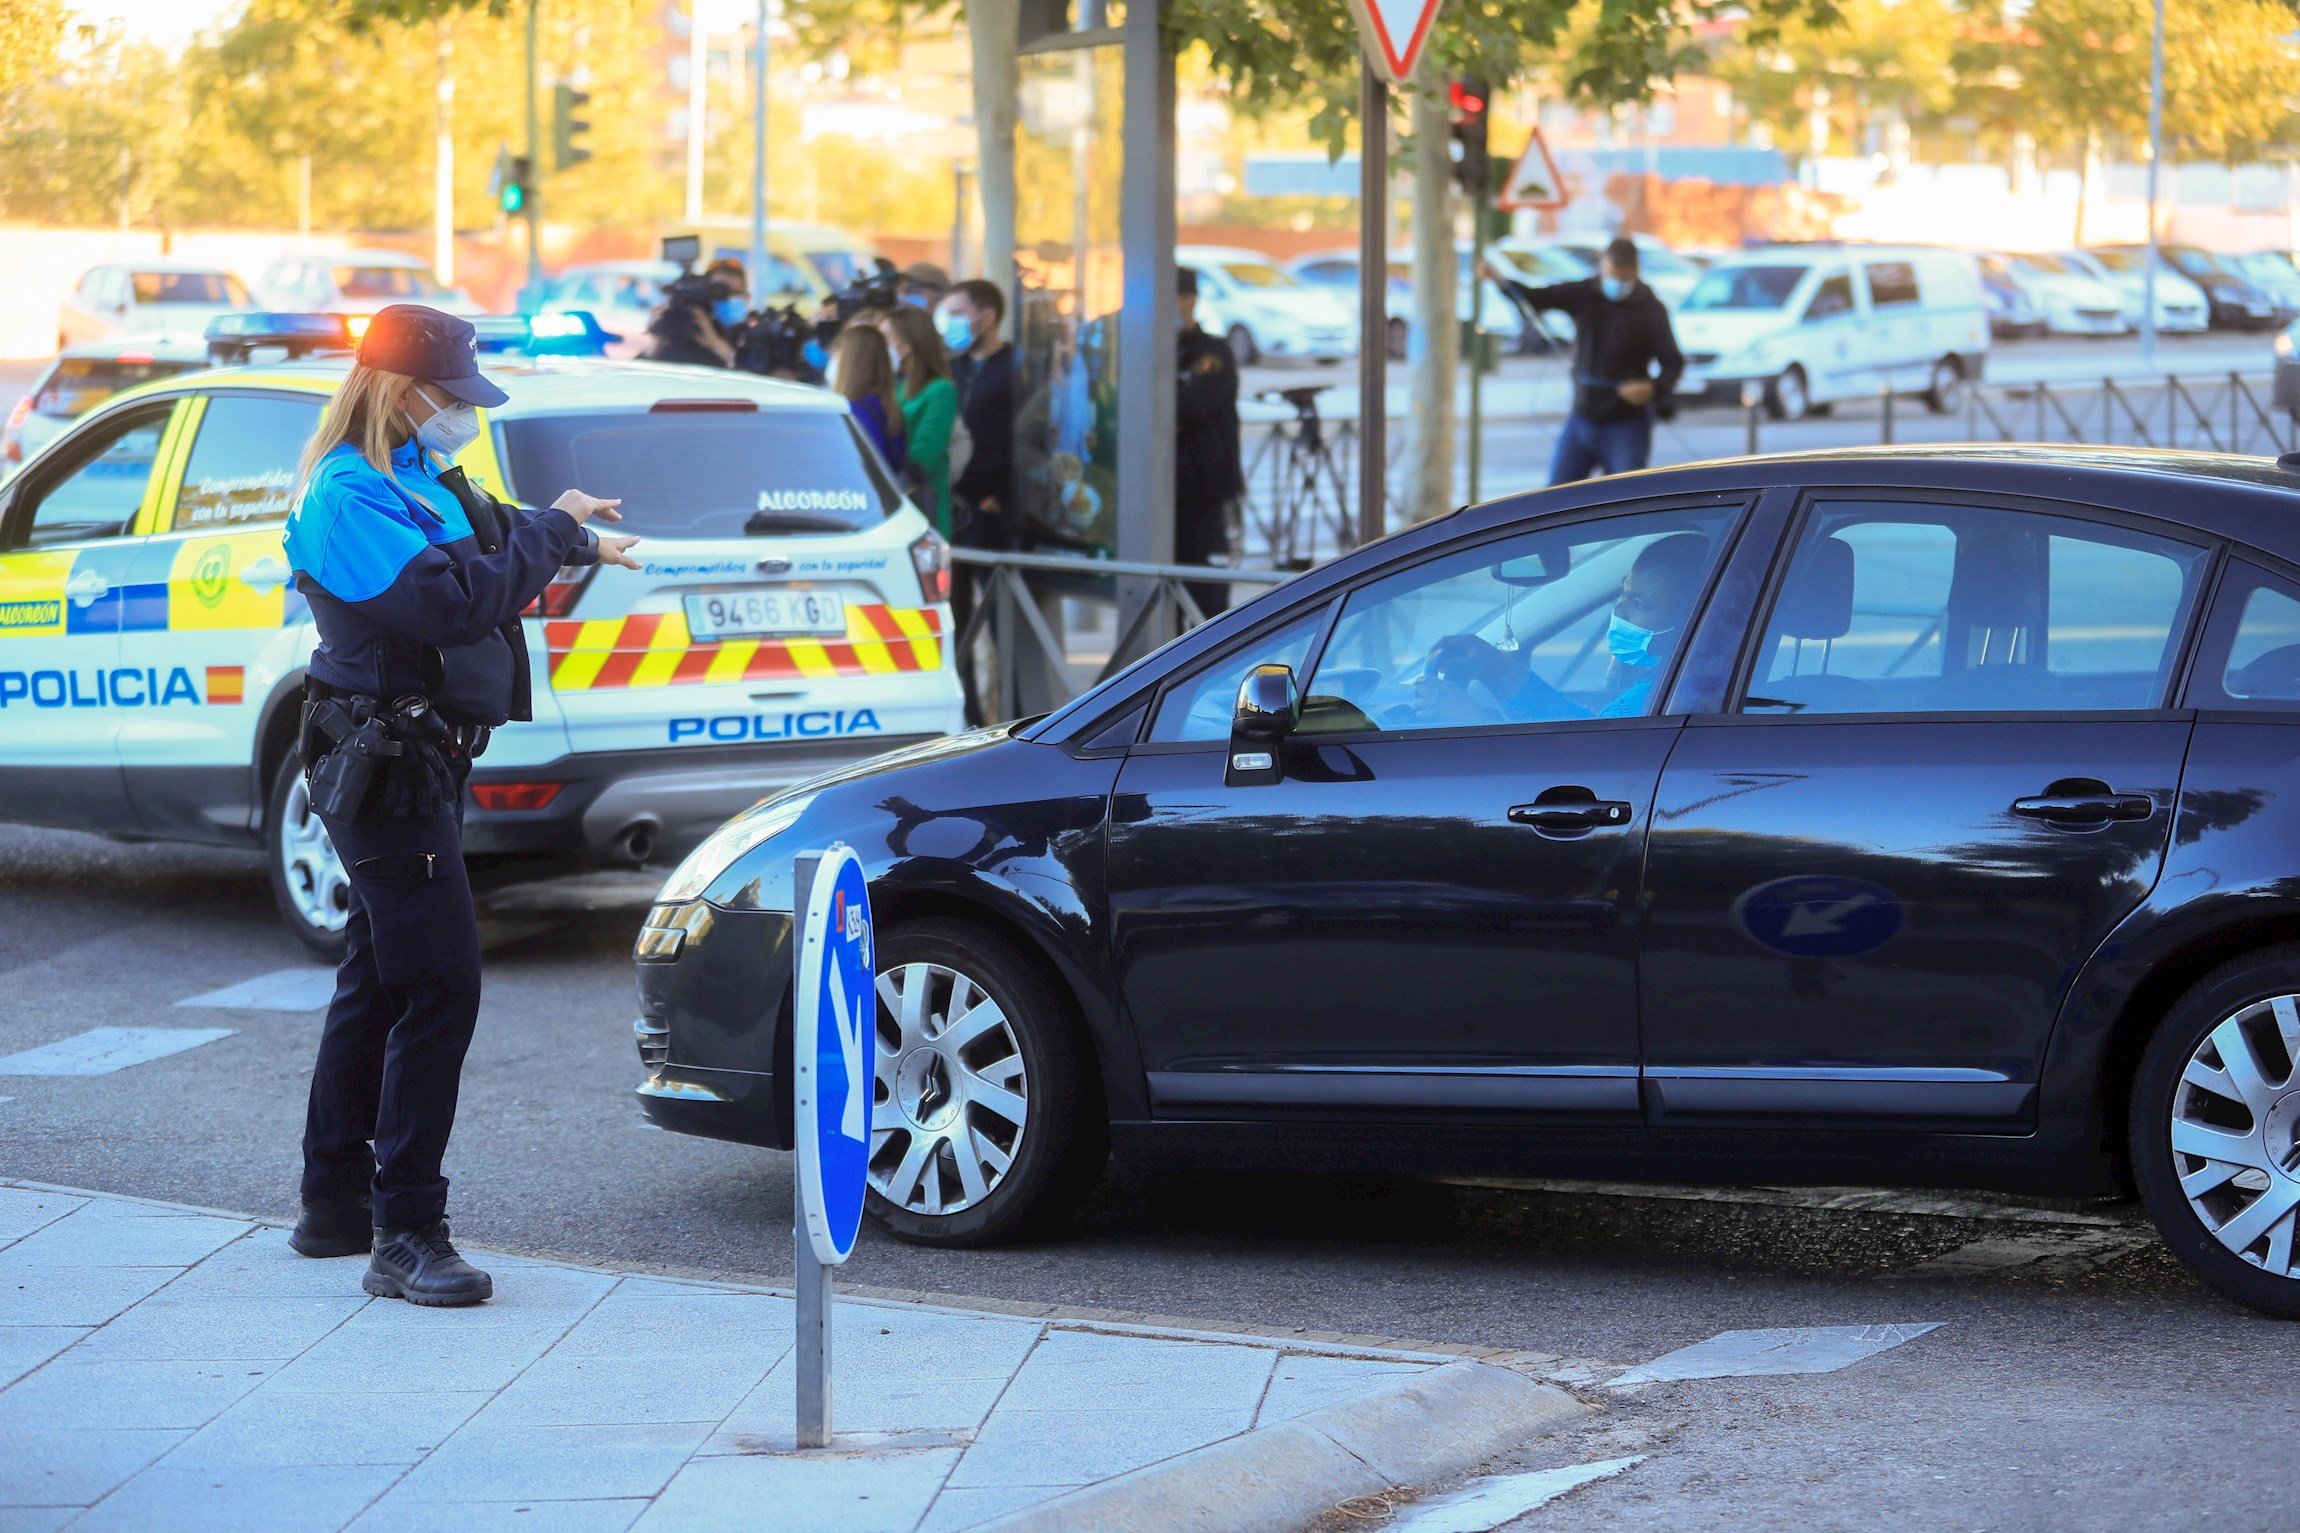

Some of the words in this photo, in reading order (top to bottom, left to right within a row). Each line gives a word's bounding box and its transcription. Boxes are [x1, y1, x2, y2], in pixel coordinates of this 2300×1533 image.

[758, 488, 867, 511] ALCORCÓN
[645, 561, 746, 577] Comprometidos
[799, 562, 818, 571] con
[836, 557, 887, 573] seguridad
[708, 598, 782, 628] 9466
[0, 667, 200, 708] POLICIA
[668, 708, 882, 743] POLICIA
